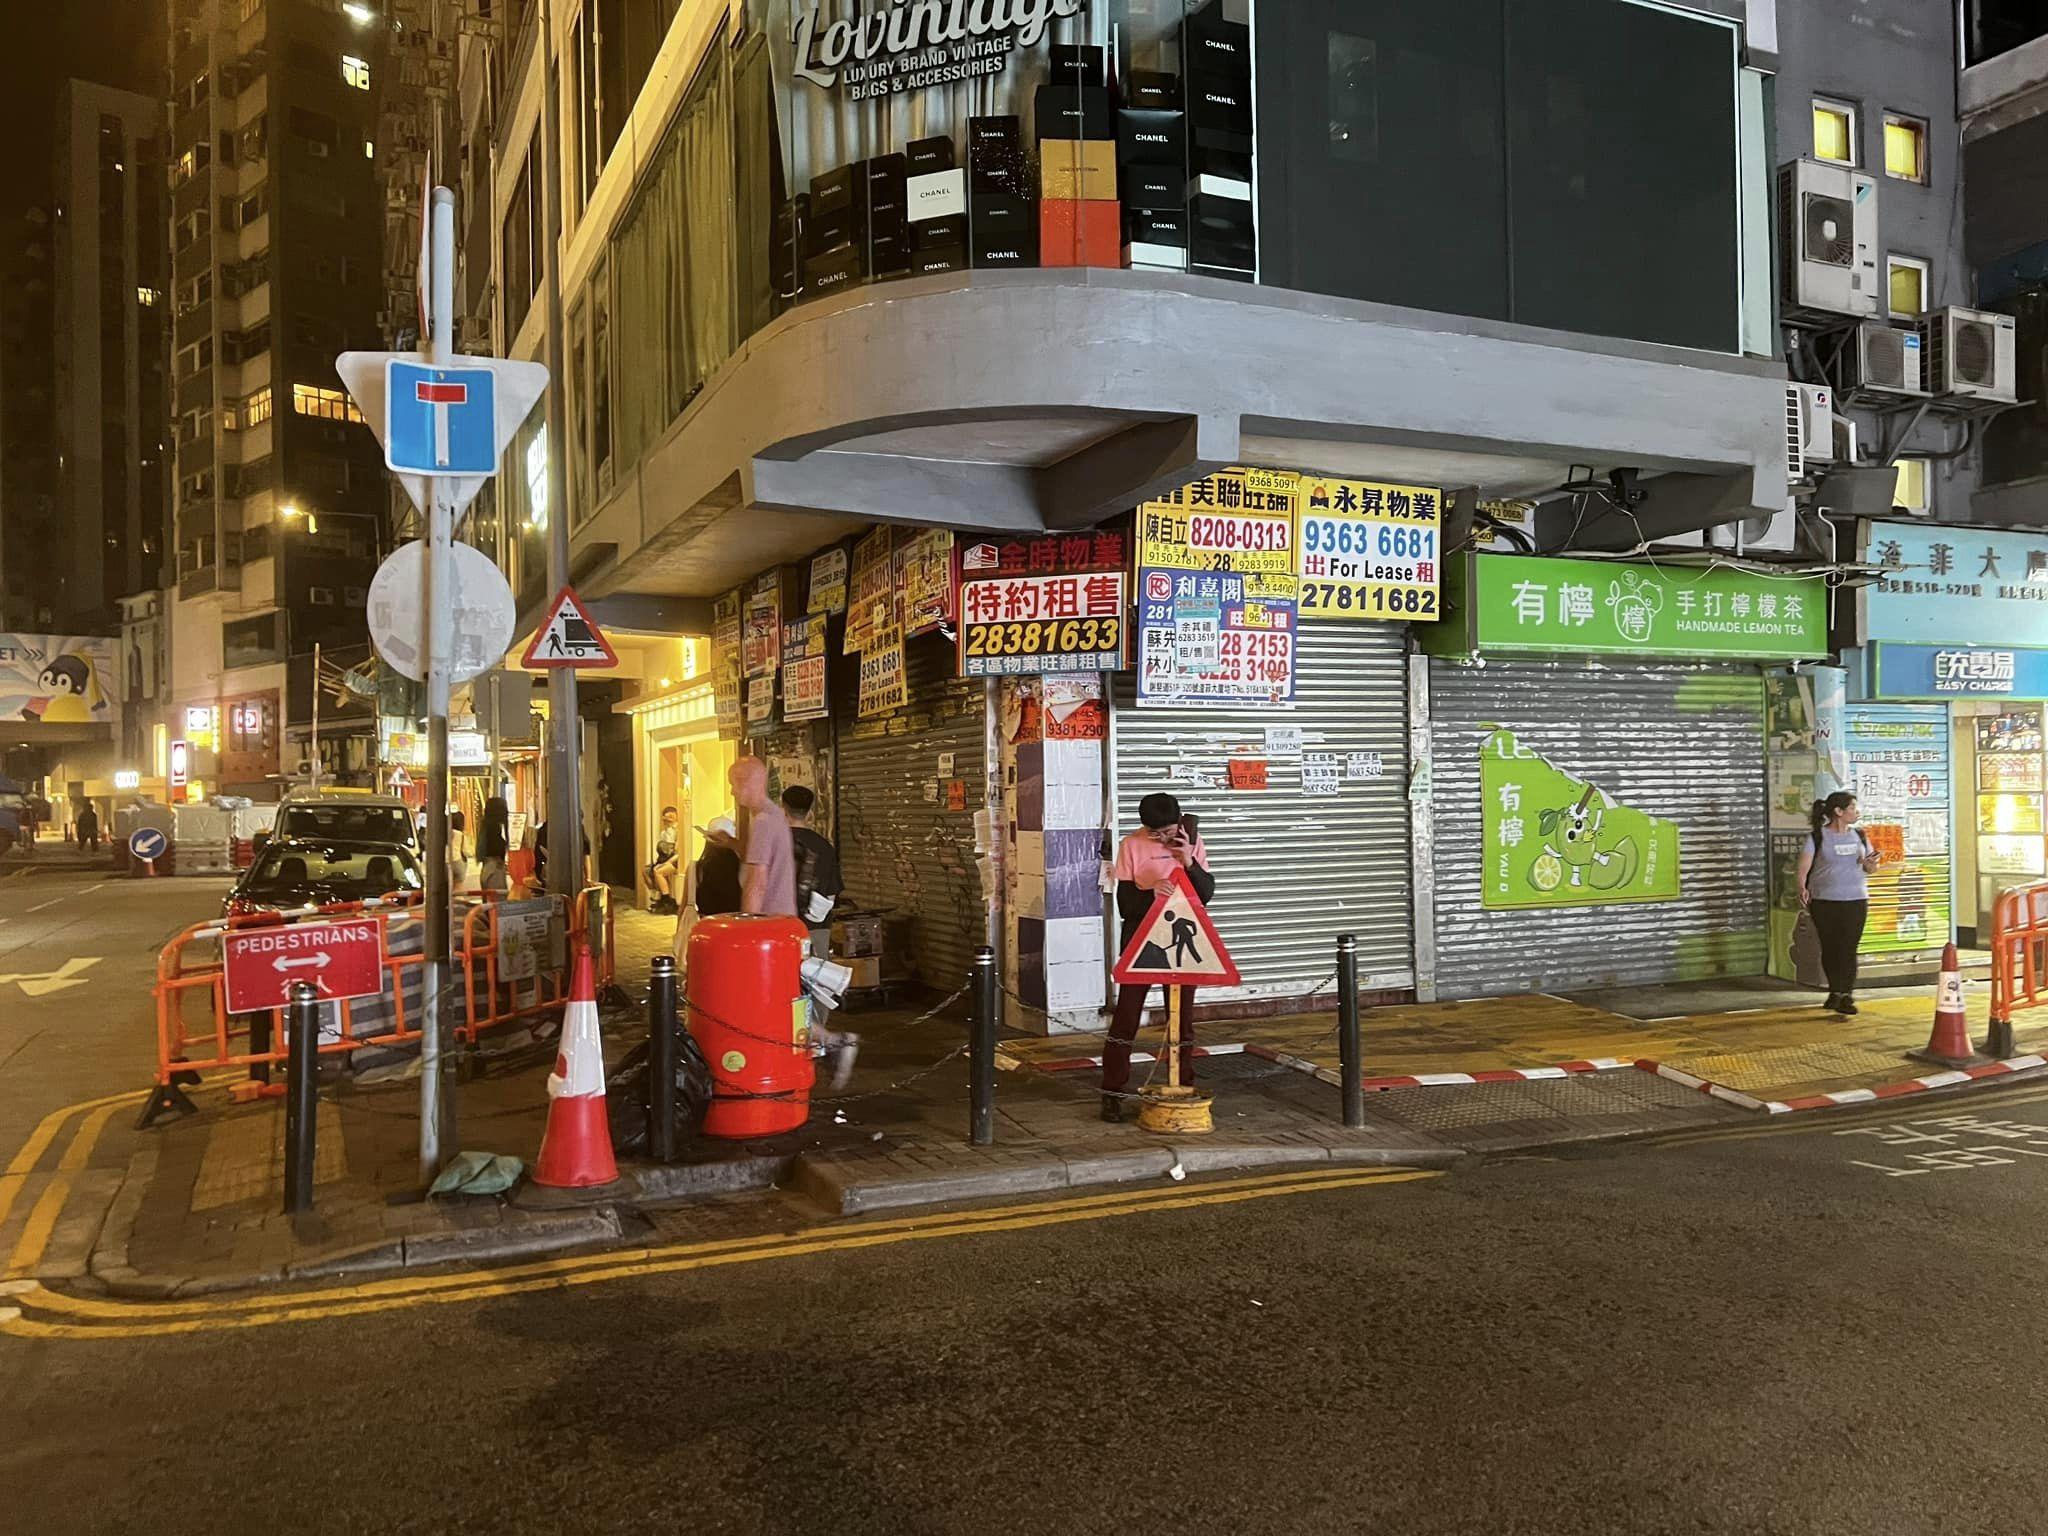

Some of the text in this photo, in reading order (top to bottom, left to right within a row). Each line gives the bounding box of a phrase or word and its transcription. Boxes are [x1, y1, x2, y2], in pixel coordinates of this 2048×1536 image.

[1205, 39, 1236, 52] CHANEL
[843, 36, 1011, 83] LUXURY BRAND VINTAGE
[852, 57, 1003, 100] BAGS & ACCESSORIES
[1206, 93, 1236, 105] CHANEL
[1135, 134, 1168, 143] CHANEL
[915, 152, 936, 161] CHANEL
[920, 187, 951, 199] CHANEL
[1152, 222, 1177, 230] CHANEL
[924, 262, 950, 271] CHANEL
[987, 252, 1019, 260] CHANEL
[818, 272, 848, 287] CHANEL
[1249, 477, 1272, 489] 9368
[1334, 485, 1436, 520] 永昇物業
[1146, 514, 1187, 544] 陳自立
[1191, 517, 1286, 550] 8208-0313
[1305, 520, 1434, 559] 9363 6681
[1000, 534, 1122, 573] 金時物業
[1149, 552, 1172, 562] 9150
[1238, 560, 1285, 569] 9283 9919
[1305, 554, 1434, 583] 出 For Lease 租
[967, 576, 1119, 622] 特約租售
[1175, 576, 1242, 602] 利嘉閣
[1301, 584, 1436, 614] 27811682
[1512, 580, 1595, 627] 有檸
[1676, 590, 1804, 620] 手打檸檬茶
[1622, 606, 1646, 635] 檸
[1676, 620, 1805, 636] HANDMADE LEMON TEA
[967, 618, 1119, 656] 28381633
[1198, 633, 1216, 642] 3619
[1247, 634, 1288, 657] 2153
[862, 651, 900, 681] 9363 6681
[968, 652, 1115, 673] 各區物業旺舖租售
[1936, 681, 2013, 692] EASY CHARGE
[860, 687, 902, 714] 27811682
[1498, 782, 1525, 847] 有檸
[237, 926, 369, 954] PEDESTRIANS
